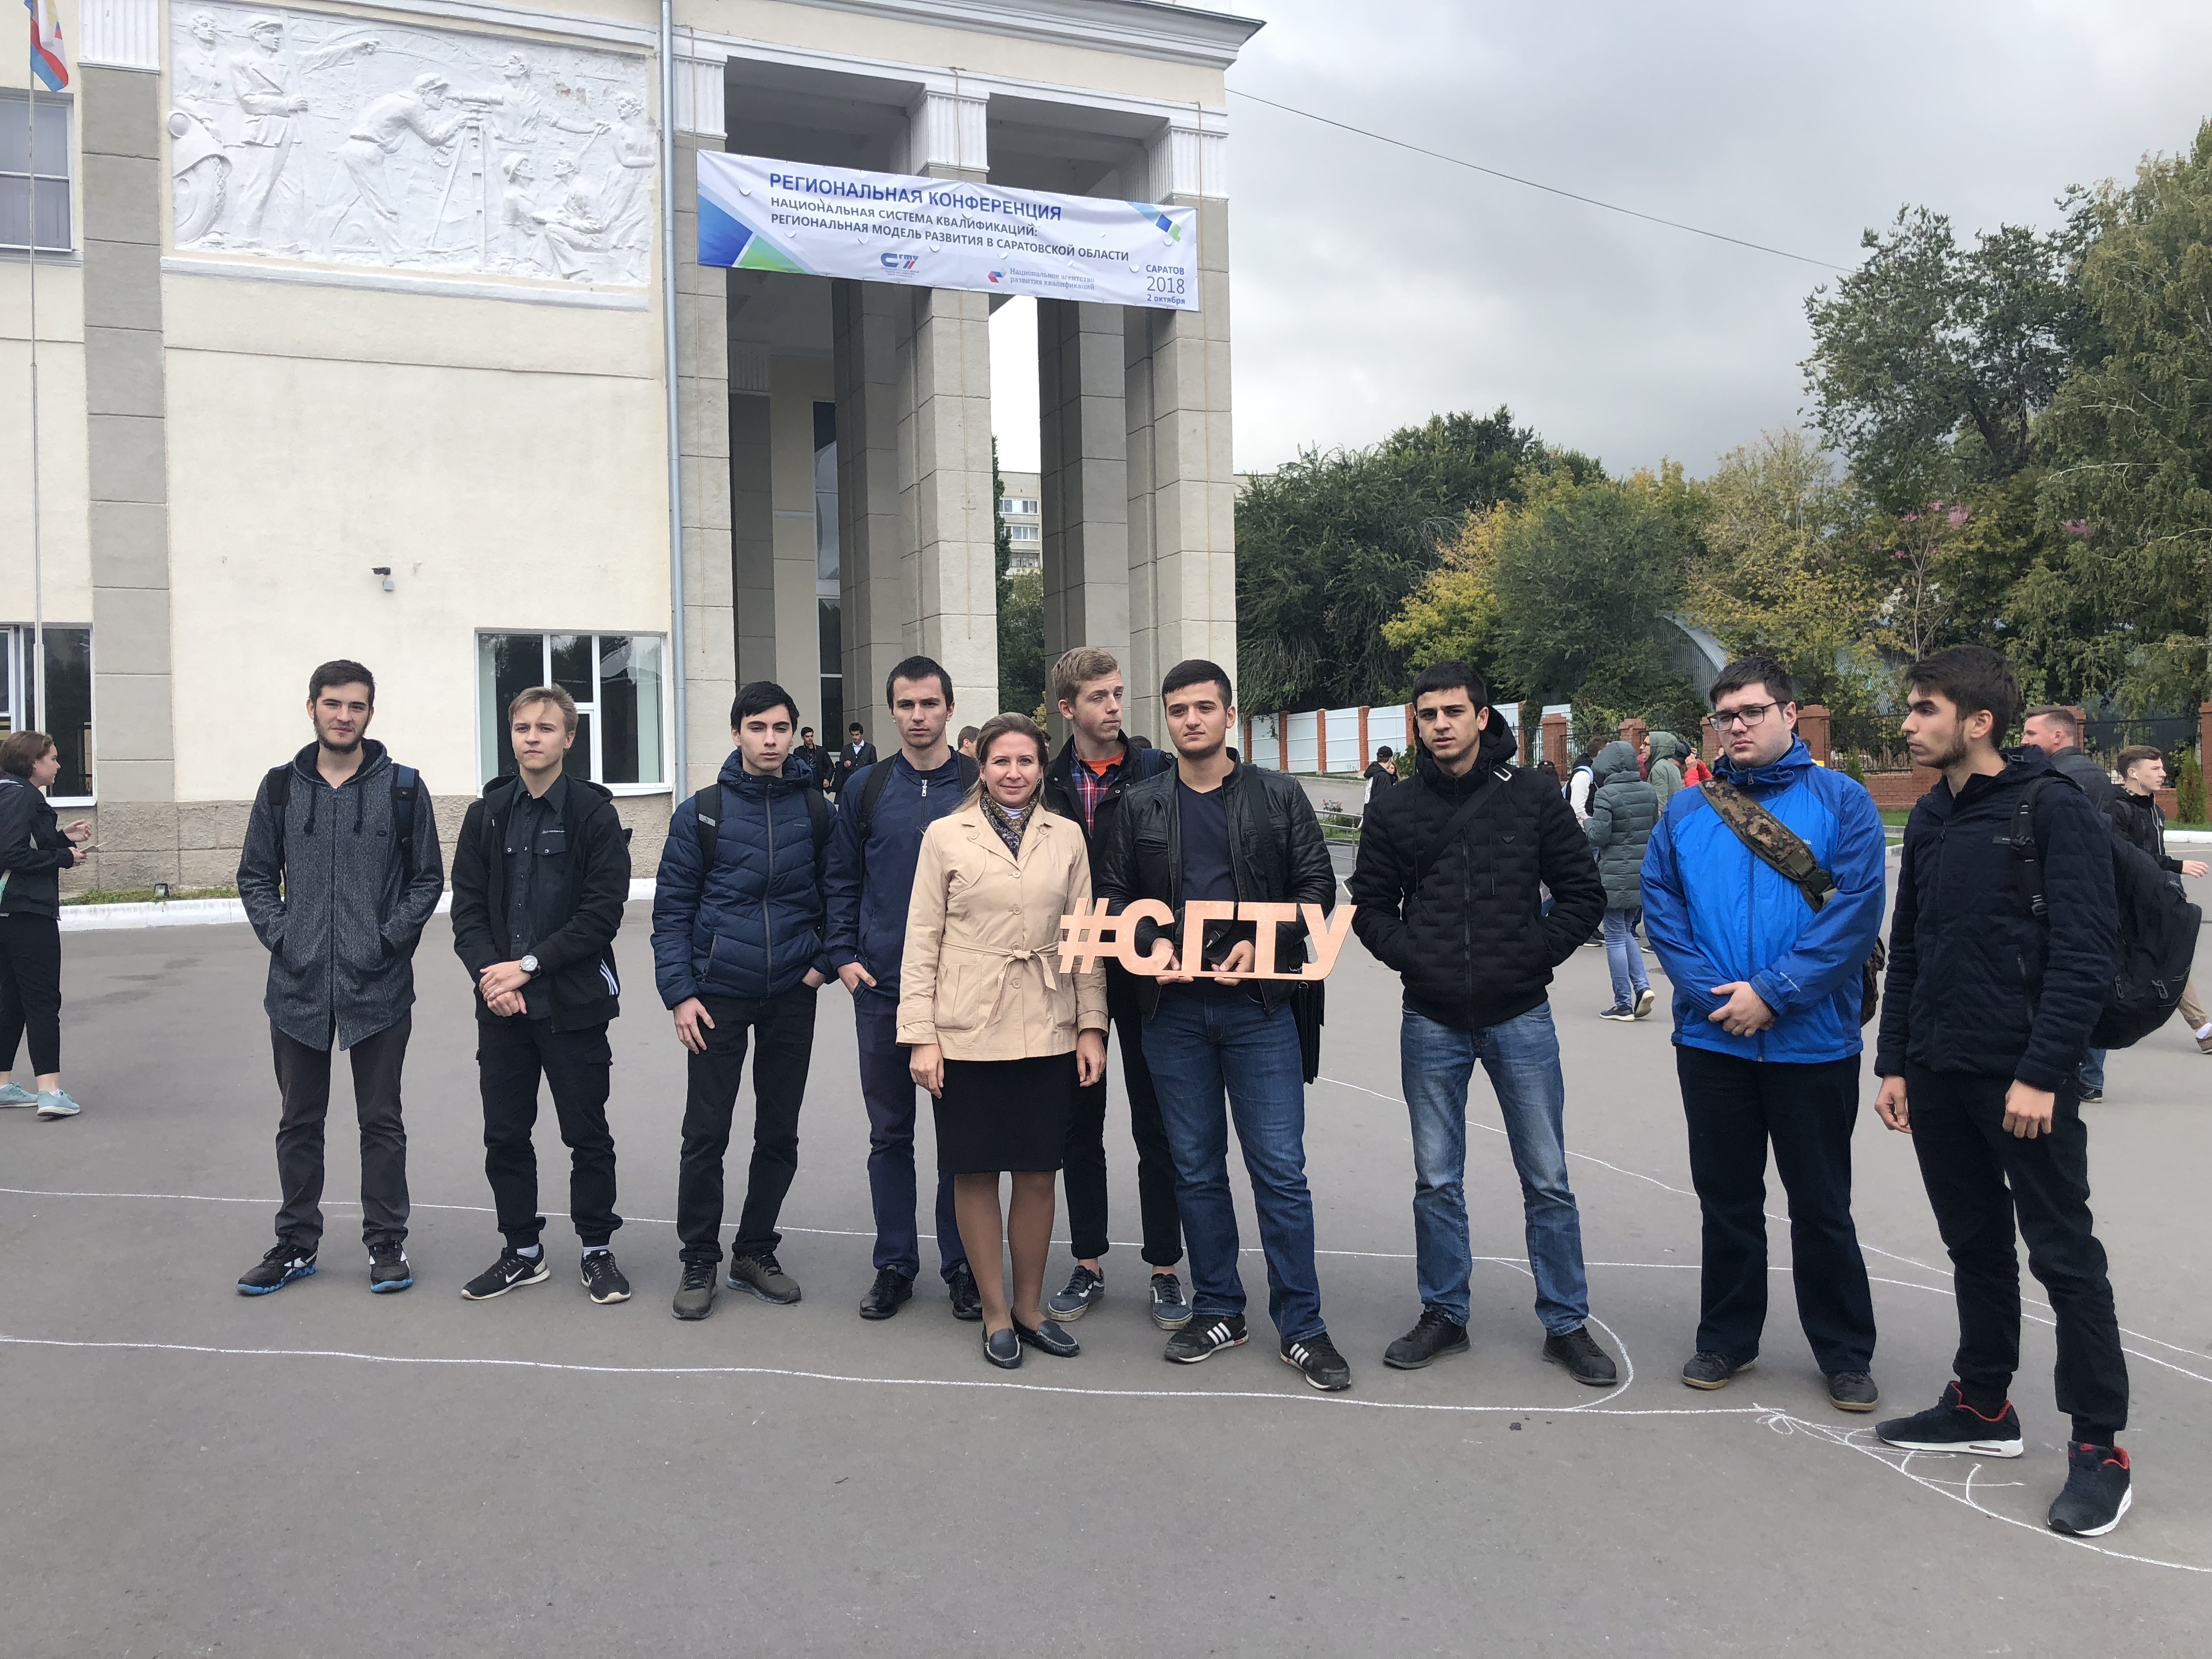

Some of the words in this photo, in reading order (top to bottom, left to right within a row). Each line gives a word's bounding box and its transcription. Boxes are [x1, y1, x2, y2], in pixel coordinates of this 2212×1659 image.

[770, 173, 923, 204] РЕГИОНАЛЬНАЯ
[929, 191, 1062, 221] КОНФЕРЕНЦИЯ
[771, 197, 874, 218] НАЦИОНАЛЬНАЯ
[878, 210, 933, 225] СИСТЕМА
[936, 216, 1038, 237] КВАЛИФИКАЦИЙ:
[771, 213, 868, 233] РЕГИОНАЛЬНАЯ
[872, 224, 922, 240] МОДЕЛЬ
[925, 231, 983, 246] РАЗВИТИЯ
[987, 238, 994, 247] В
[996, 238, 1075, 256] САРАТОВСКОЙ
[1078, 247, 1129, 261] ОБЛАСТИ
[1010, 268, 1059, 279] Национальное
[1061, 274, 1094, 283] агентство
[1146, 264, 1185, 275] САРАТОВ
[1010, 277, 1042, 285] развития
[1044, 280, 1094, 290] квалификаций
[1147, 276, 1185, 295] 2018
[1154, 296, 1186, 306] октября
[1057, 898, 1358, 981] #СГТУ
